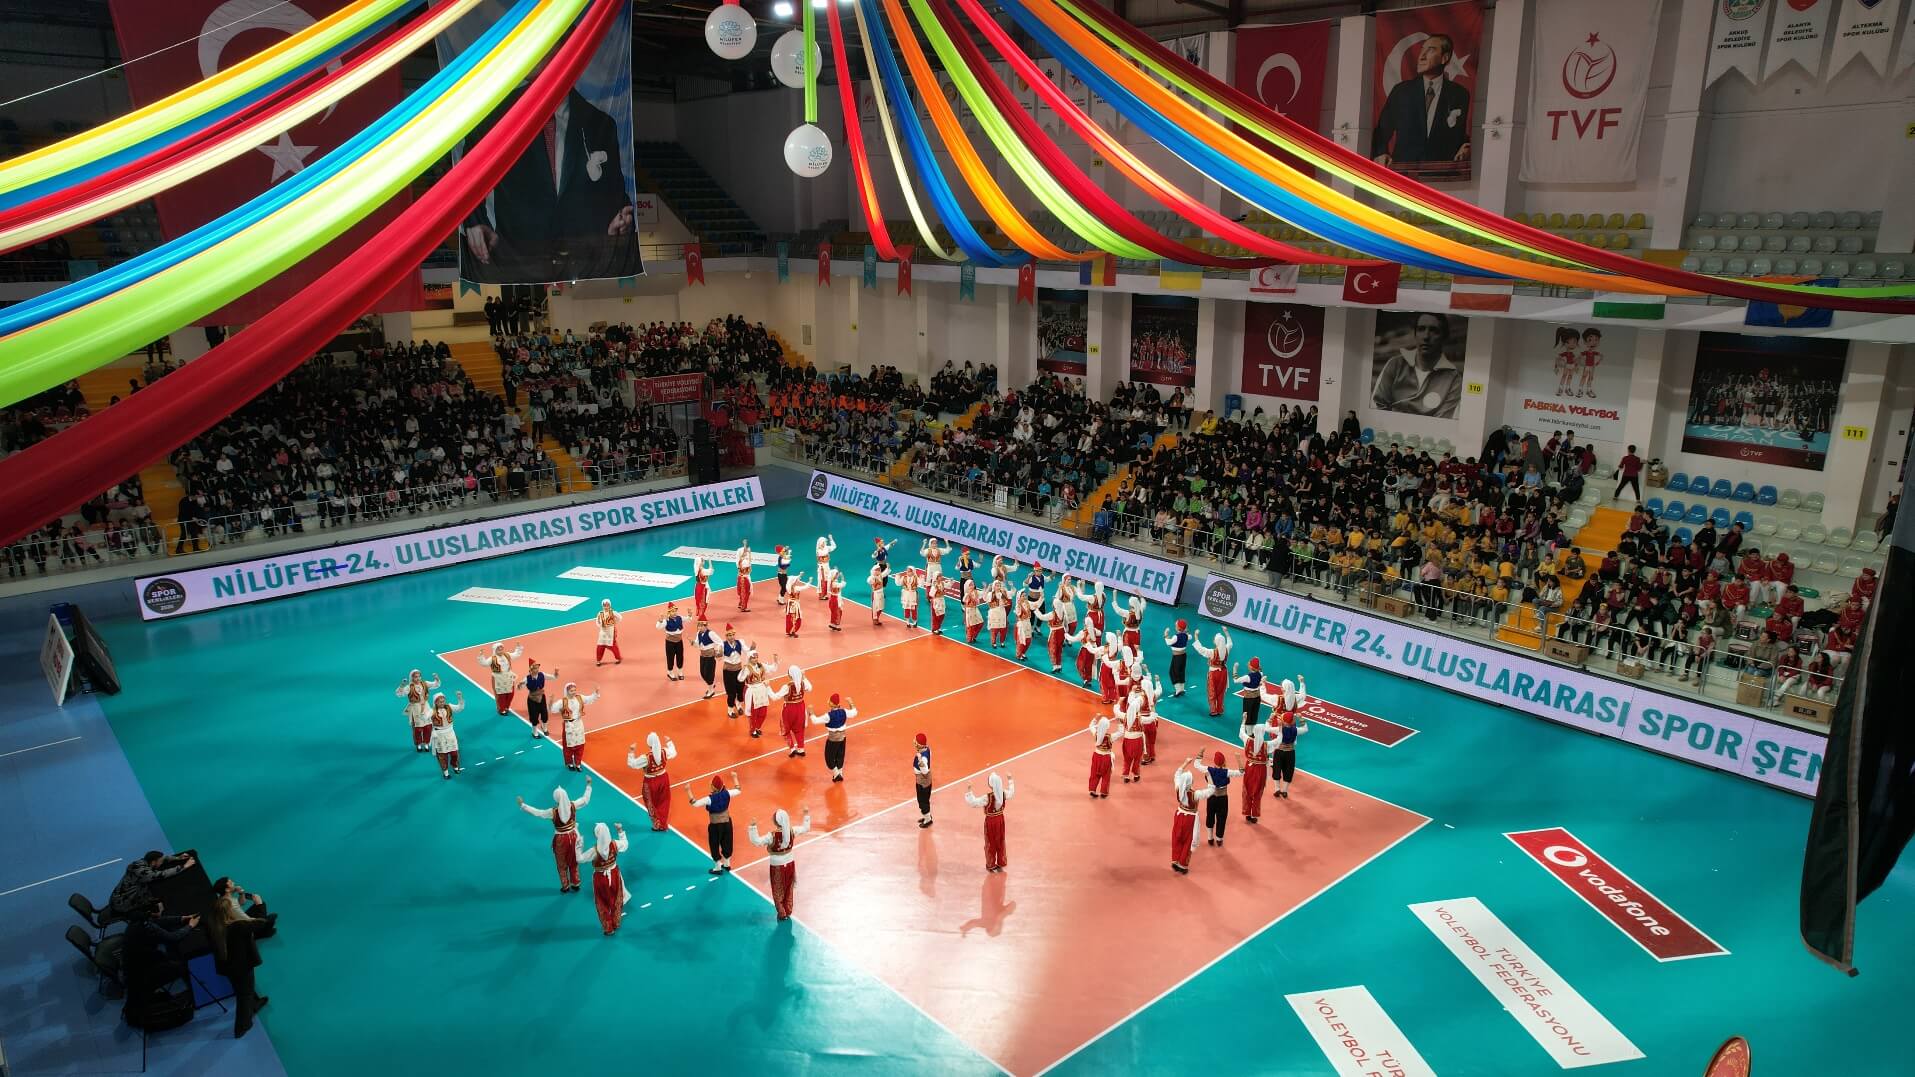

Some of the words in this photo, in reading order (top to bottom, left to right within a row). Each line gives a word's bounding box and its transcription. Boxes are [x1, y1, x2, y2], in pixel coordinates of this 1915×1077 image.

[1546, 107, 1623, 141] TVF
[1258, 363, 1311, 391] TVF
[1568, 404, 1620, 421] VOLEYBOL
[1703, 431, 1774, 446] JAPAN
[1846, 429, 1864, 440] 111
[212, 557, 340, 598] NİLÜFER
[347, 550, 390, 576] 24.
[395, 515, 572, 565] ULUSLARARASI
[580, 506, 638, 532] SPOR
[640, 481, 755, 525] ŞENLİKLERİ
[830, 482, 880, 513] NİLÜFER
[881, 498, 901, 519] 24.
[904, 504, 1014, 550] ULUSLARARASI
[1016, 534, 1062, 563] SPOR
[1064, 547, 1176, 597] ŞENLİKLERİ
[151, 588, 176, 598] SPOR
[1243, 597, 1348, 646] NİLÜFER
[1350, 627, 1393, 661] 24.
[1402, 641, 1632, 728] ULUSLARARASI
[1638, 707, 1744, 761] SPOR
[1326, 711, 1368, 729] vodafone
[1578, 868, 1670, 938] vodafone
[1435, 906, 1490, 960] VOLEYBOL
[1488, 963, 1591, 1057] FEDERASYONU
[1495, 946, 1553, 998] TÜRKİYE
[1314, 998, 1371, 1068] VOLEYBOL
